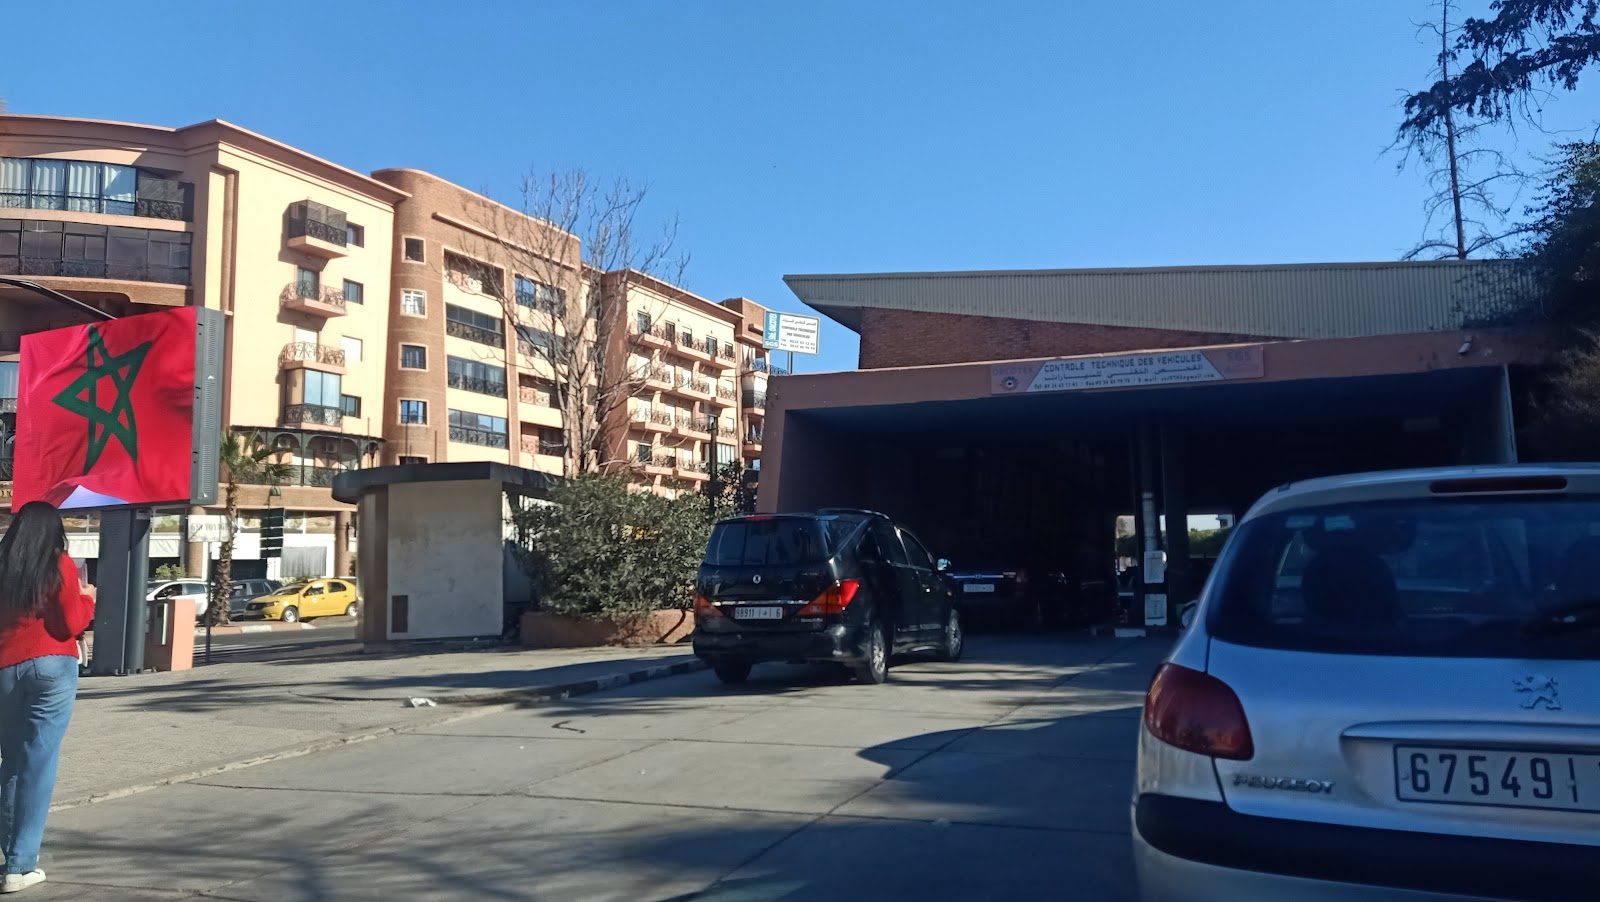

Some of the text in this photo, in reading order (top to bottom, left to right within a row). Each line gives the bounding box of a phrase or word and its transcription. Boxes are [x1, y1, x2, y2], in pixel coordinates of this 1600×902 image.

[1091, 358, 1134, 369] TECHNIQUE
[1138, 357, 1154, 367] DES
[1232, 773, 1334, 795] PEUGEOT
